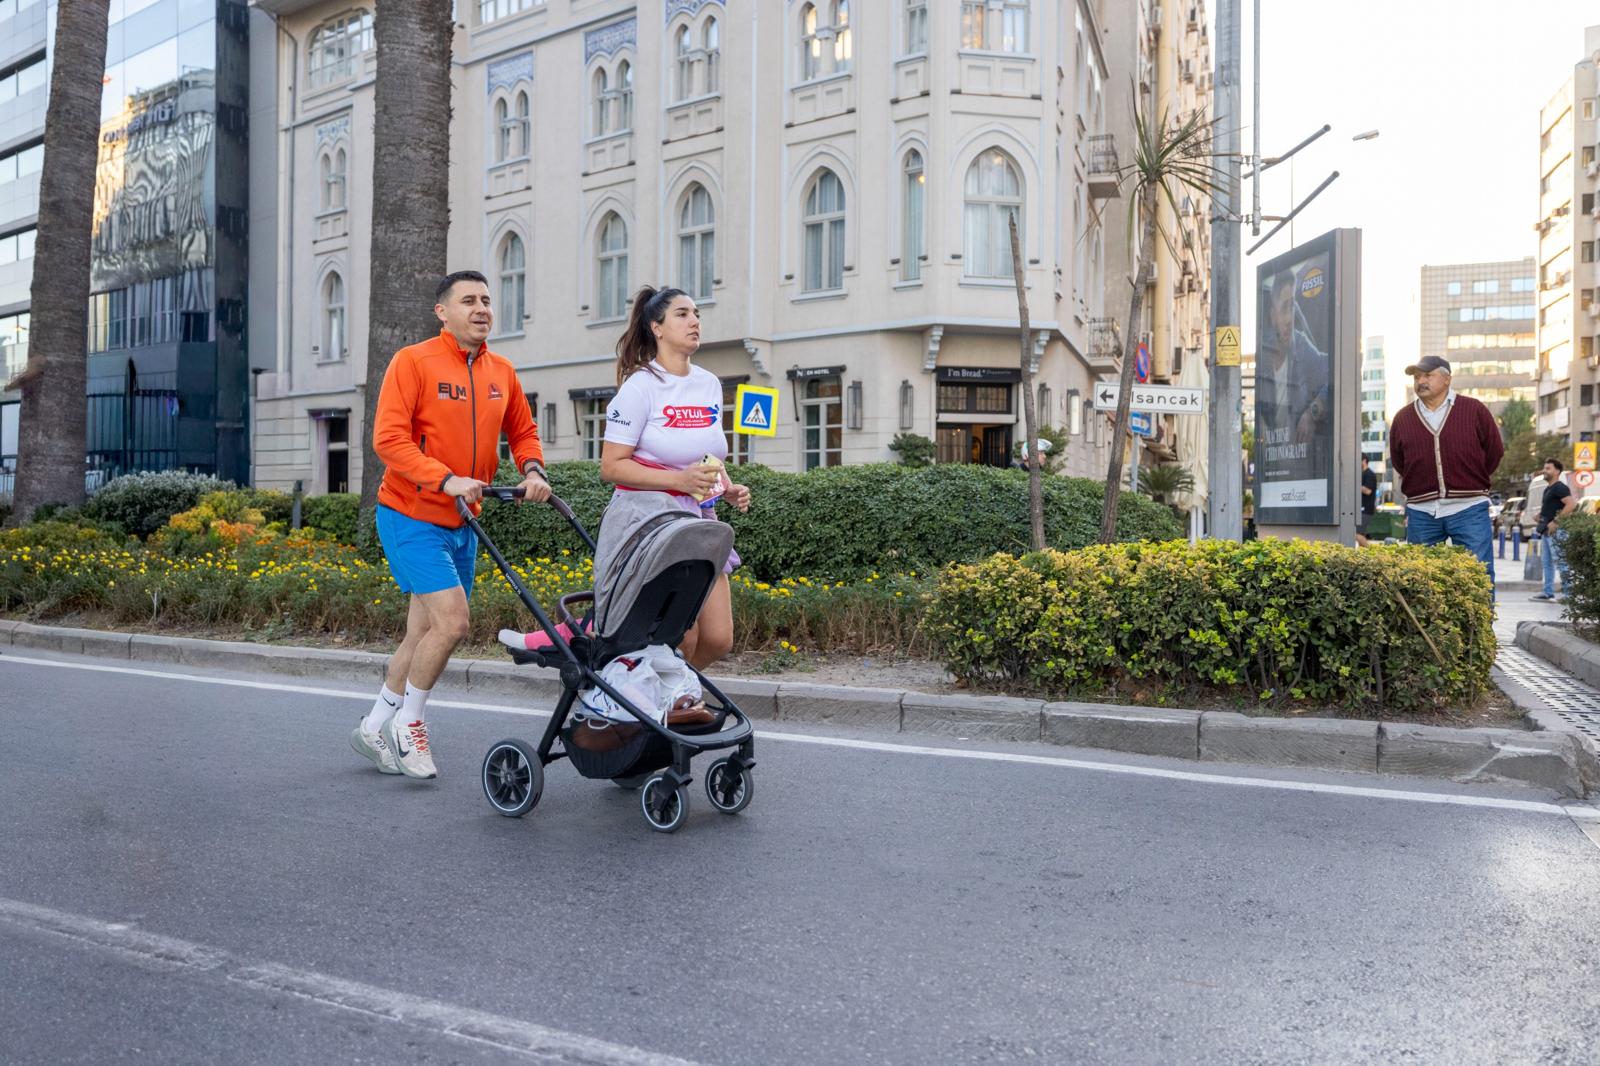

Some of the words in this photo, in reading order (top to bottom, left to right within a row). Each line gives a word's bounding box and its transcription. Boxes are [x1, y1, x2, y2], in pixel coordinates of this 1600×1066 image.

[1302, 274, 1324, 291] FOSSIL
[947, 367, 960, 377] I'm
[1131, 391, 1199, 406] lsancak
[1265, 426, 1290, 444] MACHINE
[1265, 442, 1307, 461] CHRONOGRAPH
